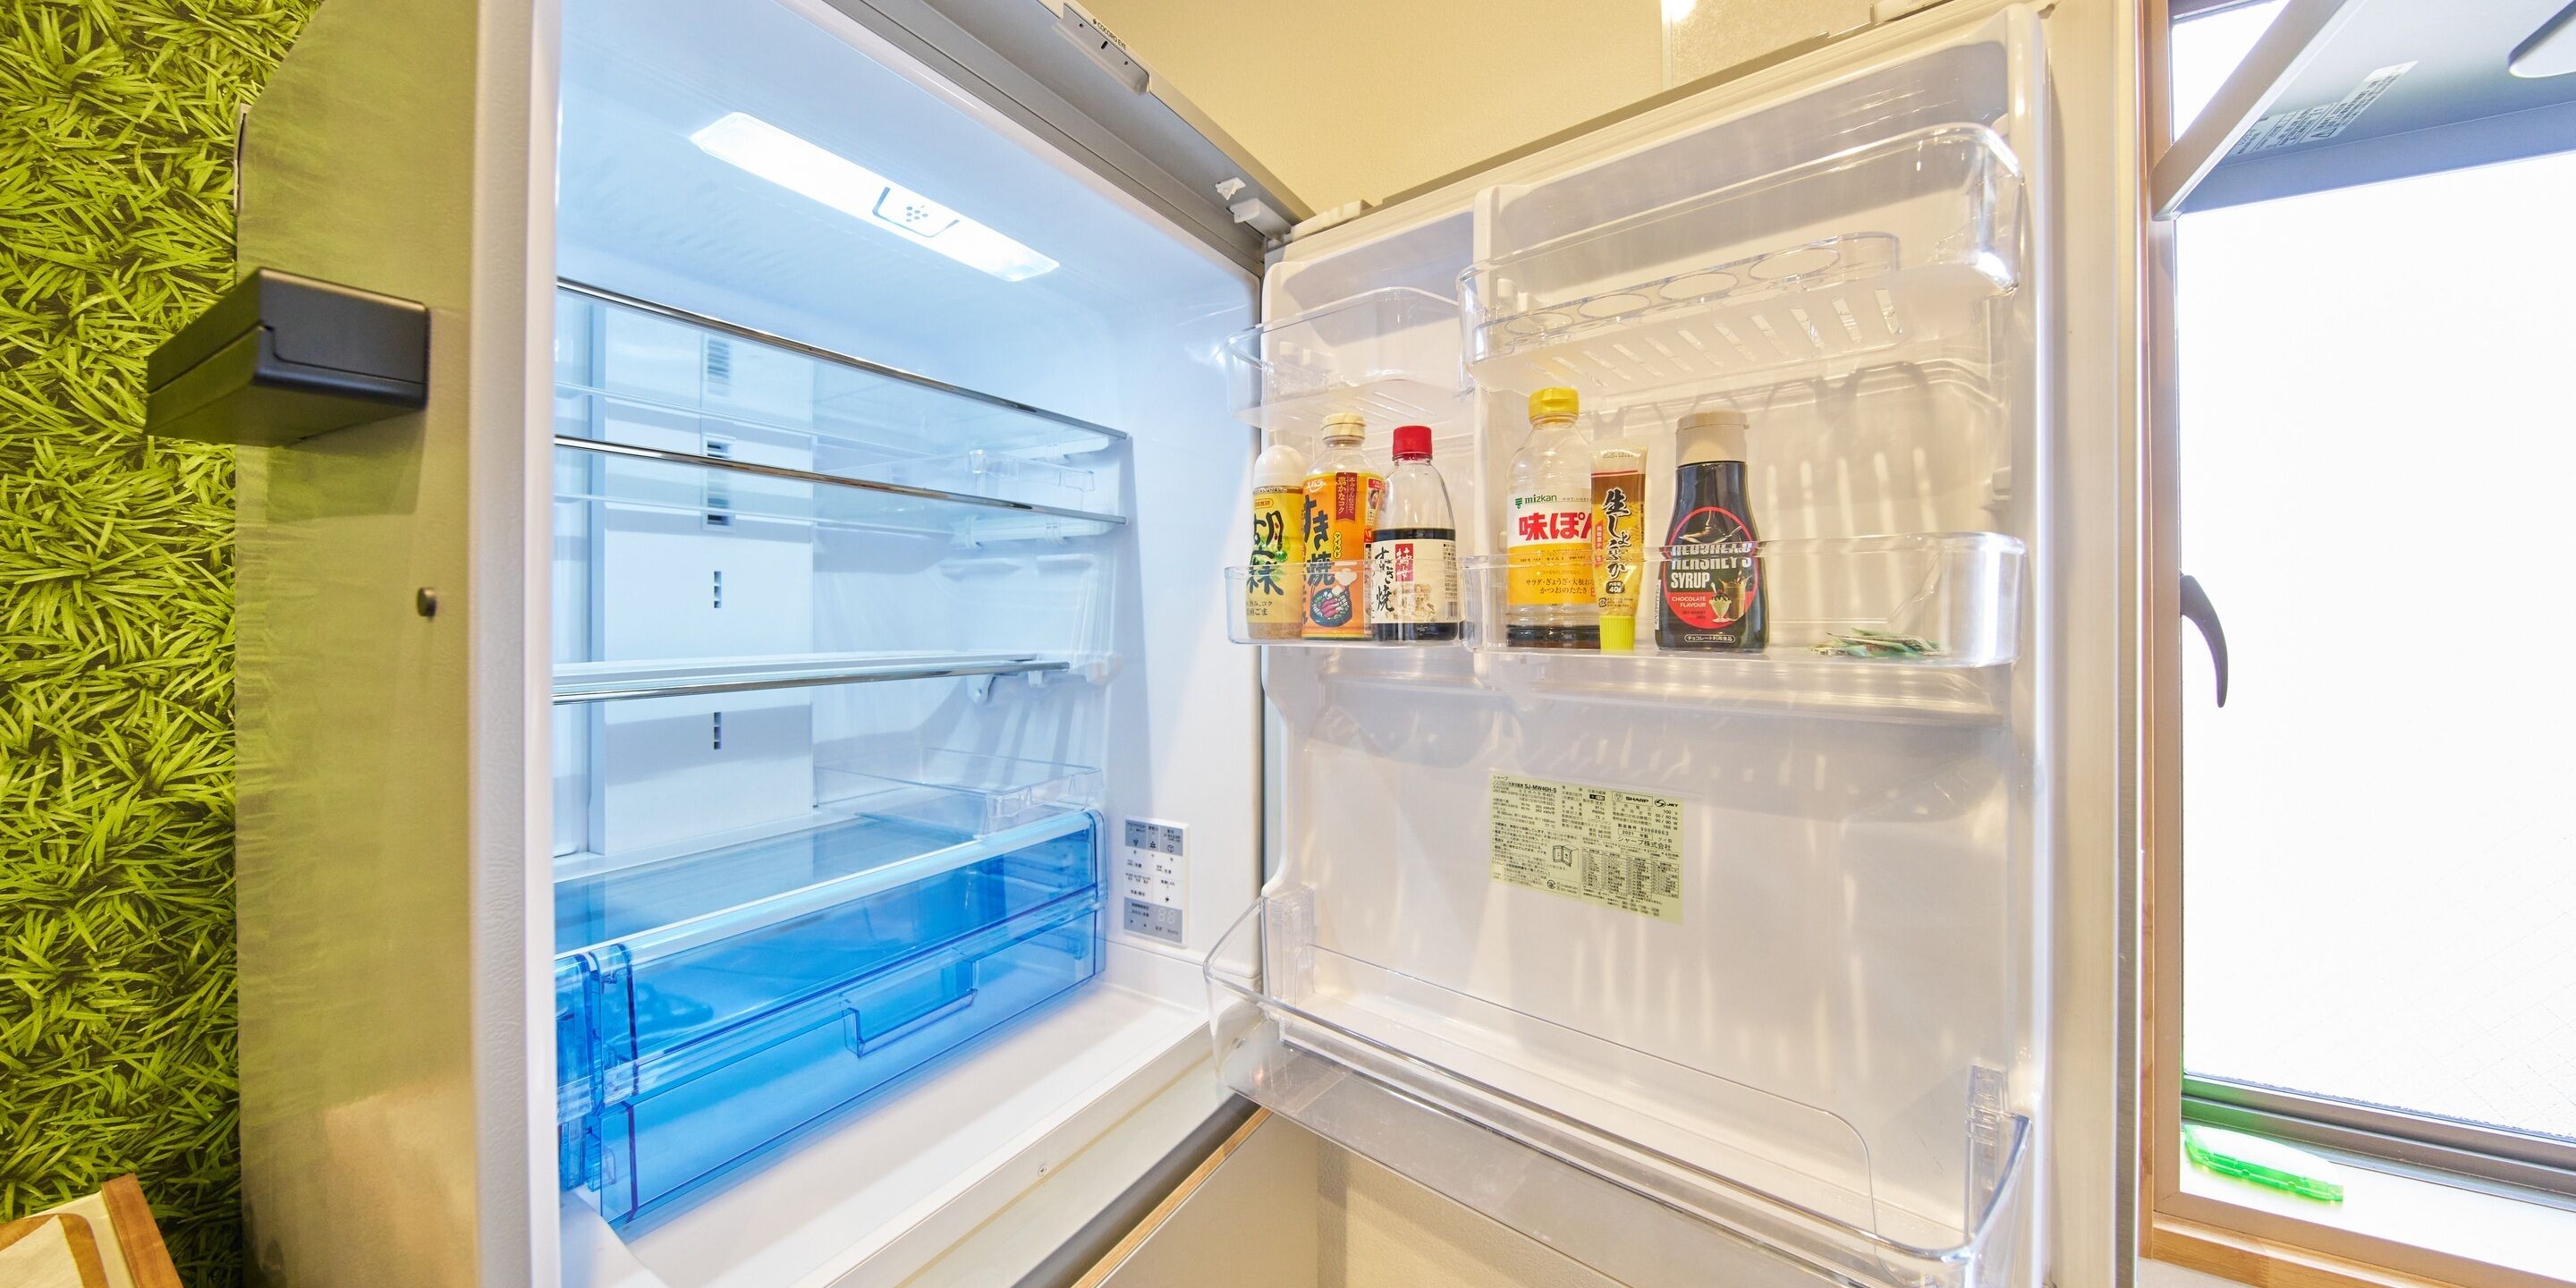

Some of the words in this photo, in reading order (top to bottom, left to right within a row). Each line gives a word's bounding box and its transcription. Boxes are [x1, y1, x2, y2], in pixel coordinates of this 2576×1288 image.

[1097, 22, 1117, 42] COCORO
[1118, 39, 1127, 50] EYE
[1337, 477, 1346, 514] 豊かなコク
[1525, 494, 1557, 504] mizkan
[1670, 572, 1710, 589] SYRUP
[1539, 586, 1589, 595] かつおのたたき
[1617, 836, 1672, 852] シャープ株式会社
